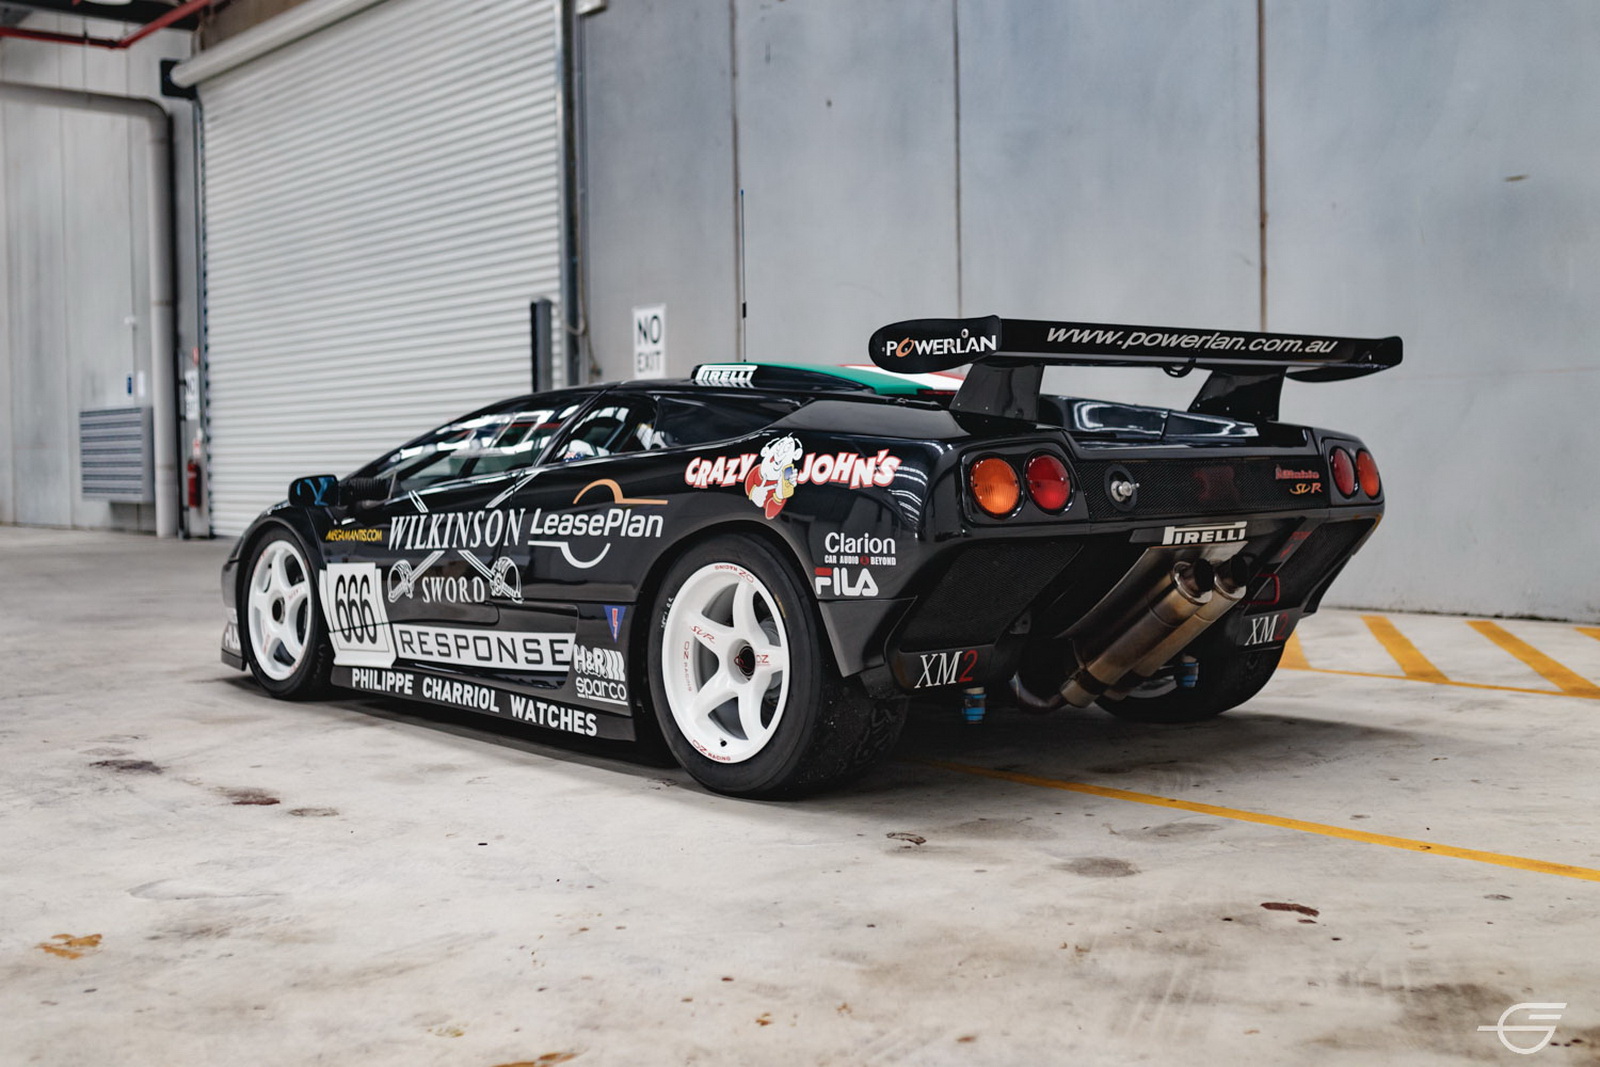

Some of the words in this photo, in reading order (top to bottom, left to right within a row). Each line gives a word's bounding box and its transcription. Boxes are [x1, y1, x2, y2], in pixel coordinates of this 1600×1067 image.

[637, 314, 661, 344] NO
[1046, 327, 1338, 353] www.powerlan.com.au
[886, 335, 997, 358] POWERLAN
[638, 351, 661, 373] EXIT
[695, 365, 758, 381] PIRELLI
[685, 453, 758, 489] CRAZY
[797, 449, 902, 489] JOHN'S
[388, 508, 525, 550] WILKINSON
[530, 508, 664, 537] LeasePlan
[1162, 521, 1248, 545] PIRELLI
[824, 532, 896, 554] Clarion
[824, 555, 837, 564] CAR
[839, 556, 859, 564] AUDIO
[870, 557, 896, 566] BEYOND
[421, 576, 486, 603] SWORD
[814, 567, 879, 596] FILA
[335, 574, 377, 645] 666
[1244, 613, 1289, 647] XM2
[399, 630, 570, 666] RESPONSE
[914, 650, 978, 689] XM2
[351, 668, 414, 695] PHILIPPE
[422, 677, 500, 713] CHARRIOL
[510, 694, 598, 737] WATCHES
[576, 677, 627, 701] sparco
